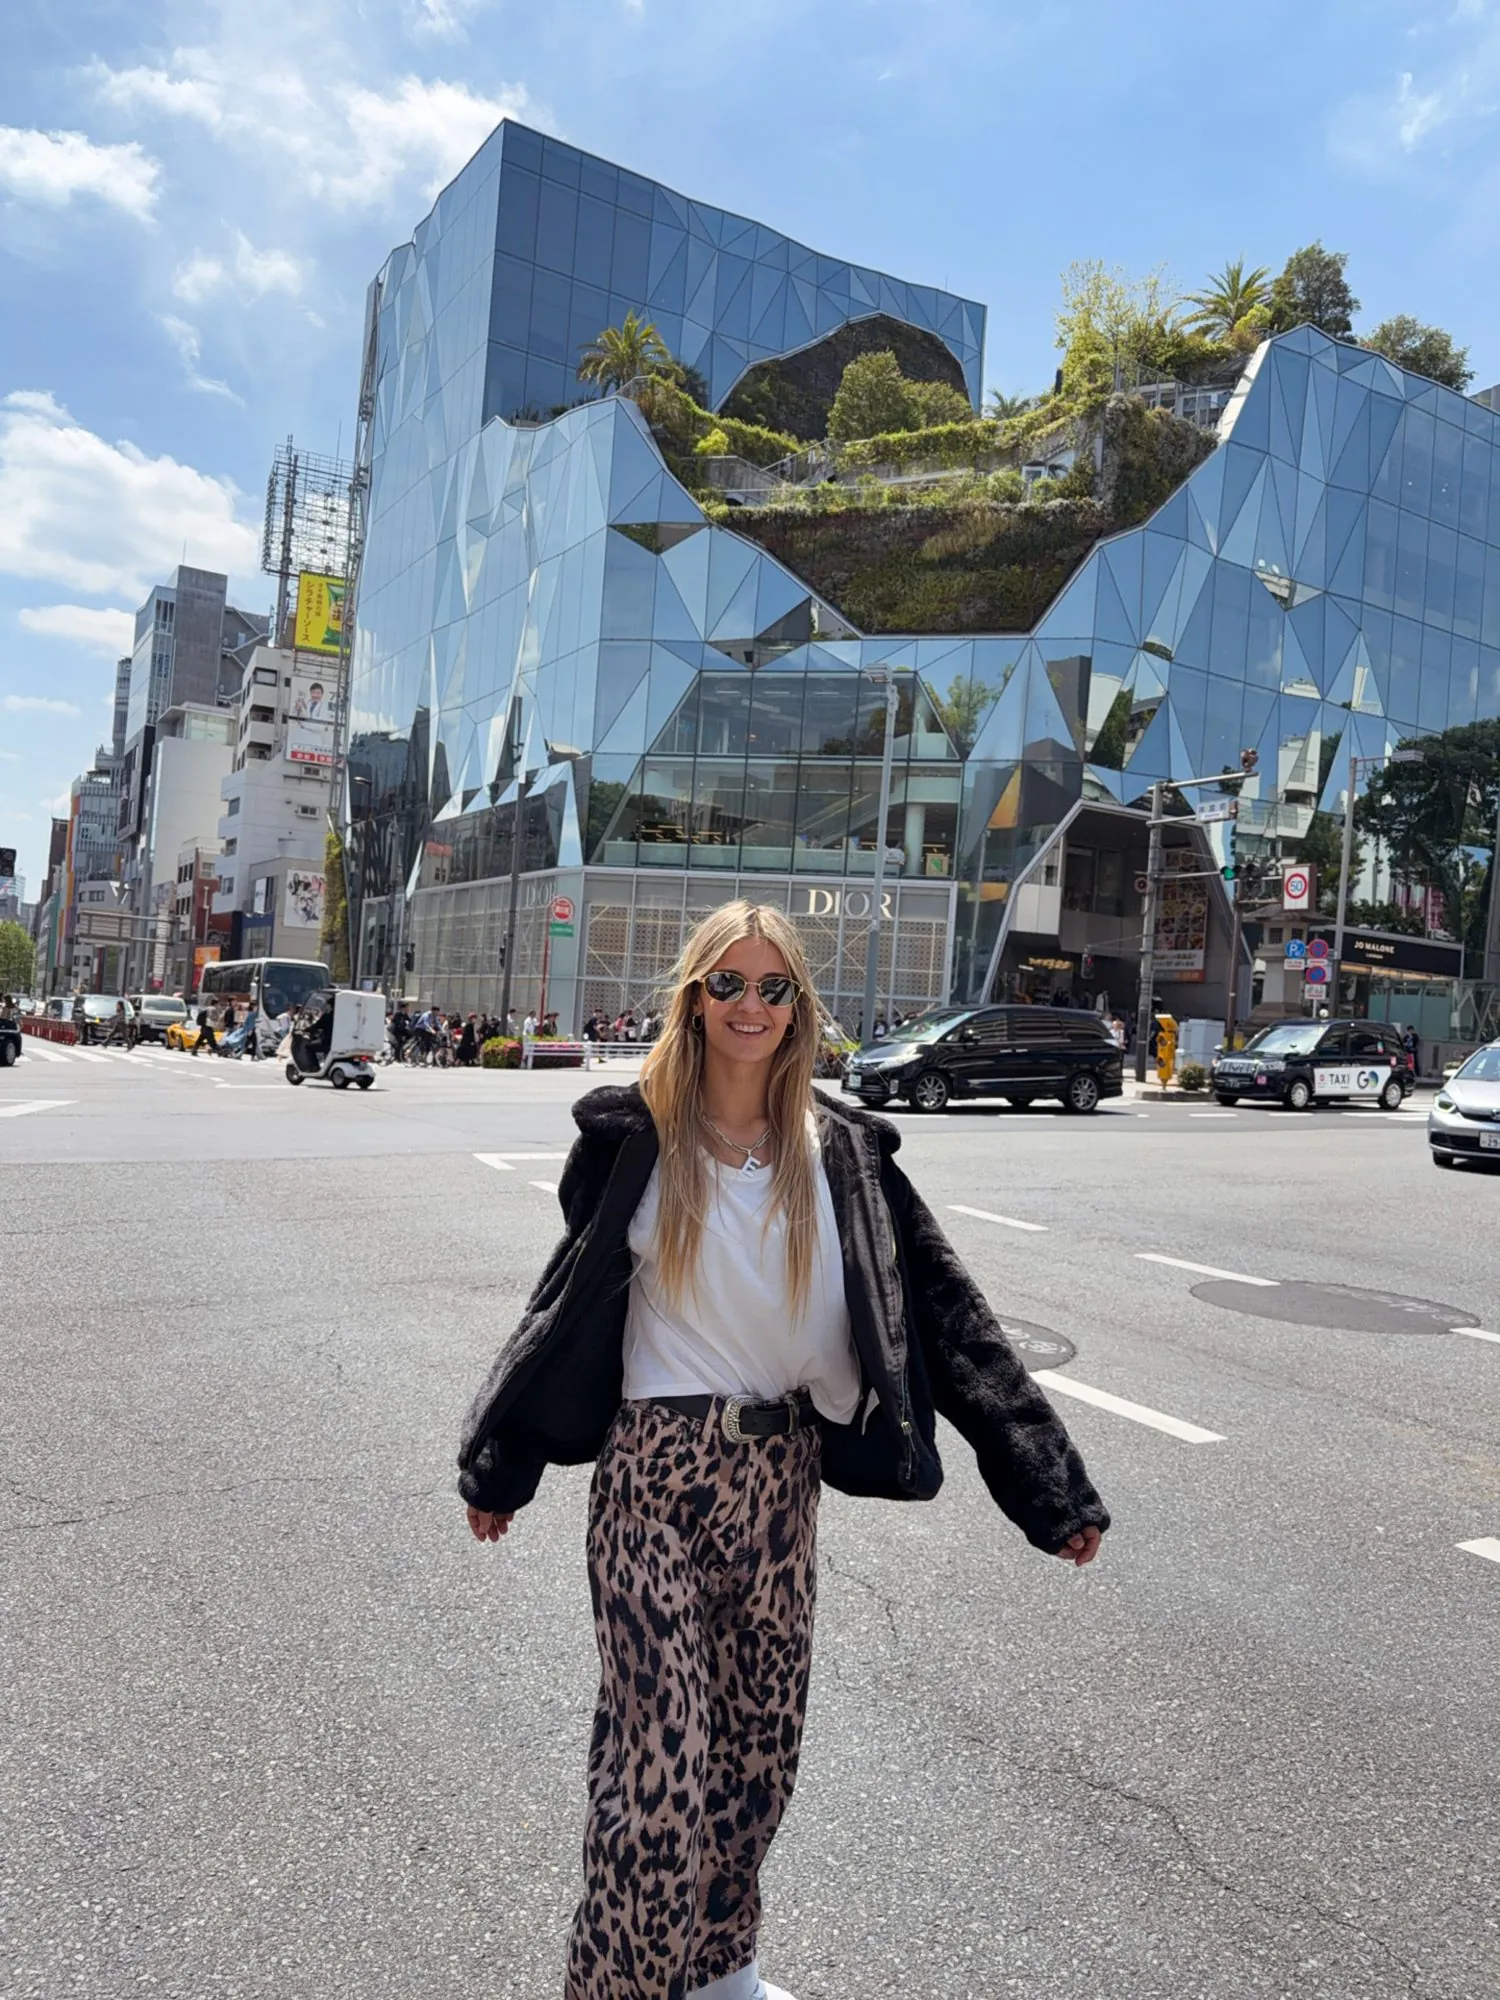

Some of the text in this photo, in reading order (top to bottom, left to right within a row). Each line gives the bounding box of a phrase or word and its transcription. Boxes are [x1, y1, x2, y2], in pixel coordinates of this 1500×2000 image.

[301, 580, 315, 642] シラチャーソース
[1290, 880, 1303, 892] 50
[806, 888, 894, 919] DIOR
[1289, 944, 1298, 957] P
[1354, 940, 1395, 954] JO MALONE
[1329, 1070, 1379, 1090] TAXI GO
